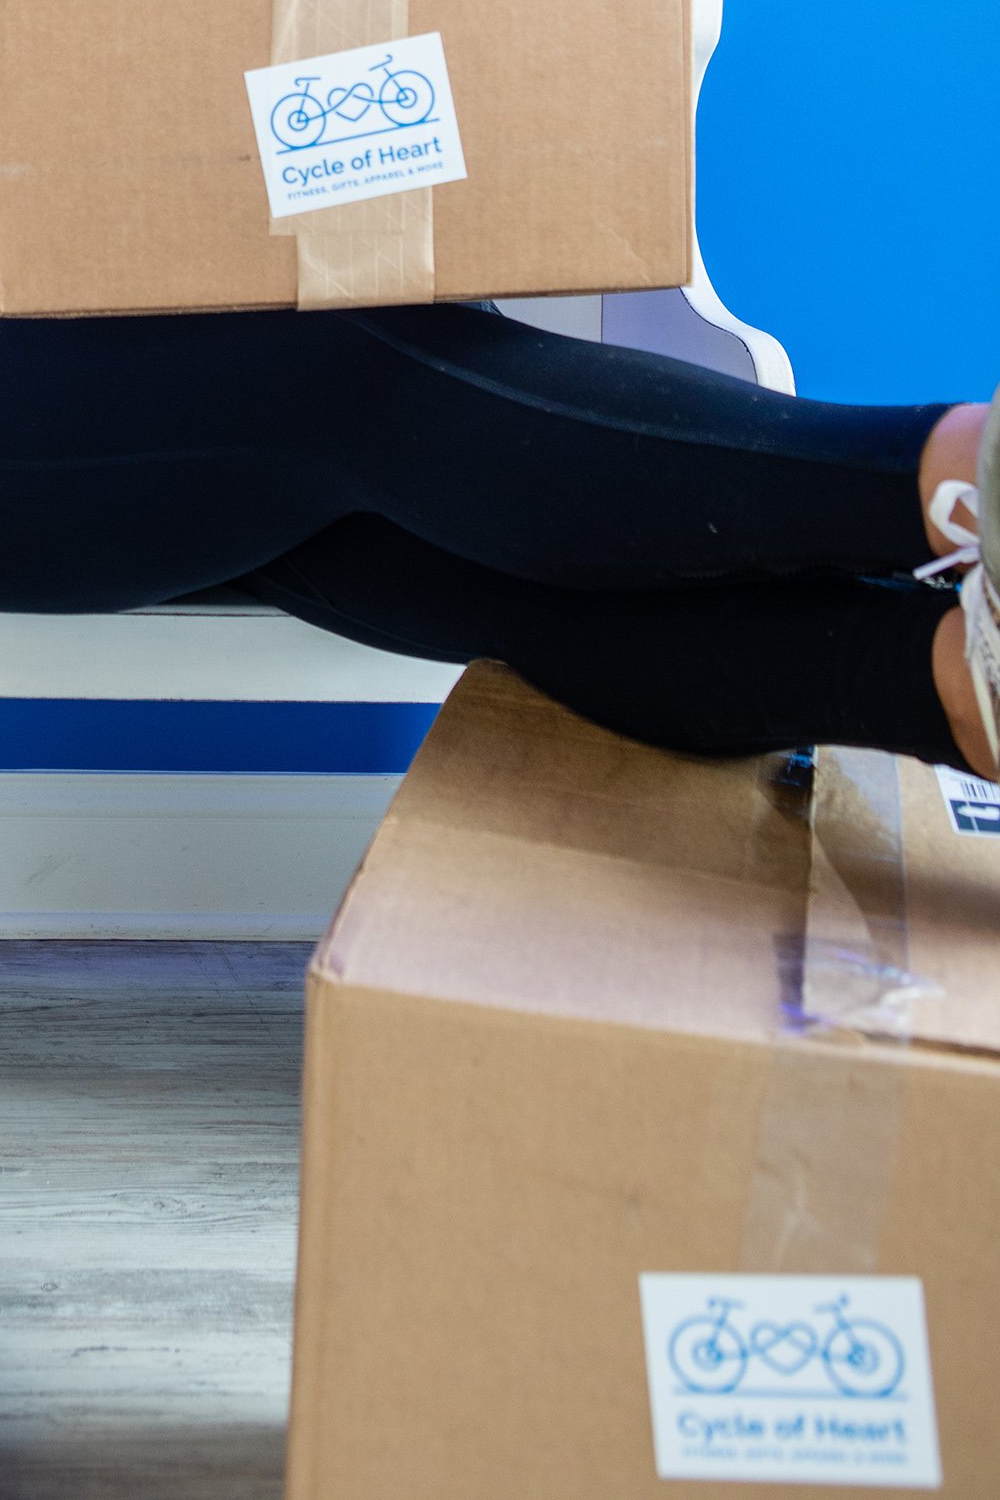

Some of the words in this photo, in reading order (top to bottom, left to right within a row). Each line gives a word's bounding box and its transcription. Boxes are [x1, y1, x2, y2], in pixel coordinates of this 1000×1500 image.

[281, 159, 344, 187] Cycle
[350, 149, 373, 170] of
[378, 136, 443, 165] Heart
[677, 1410, 764, 1447] Cycle
[774, 1413, 804, 1440] of
[814, 1414, 906, 1443] Heart
